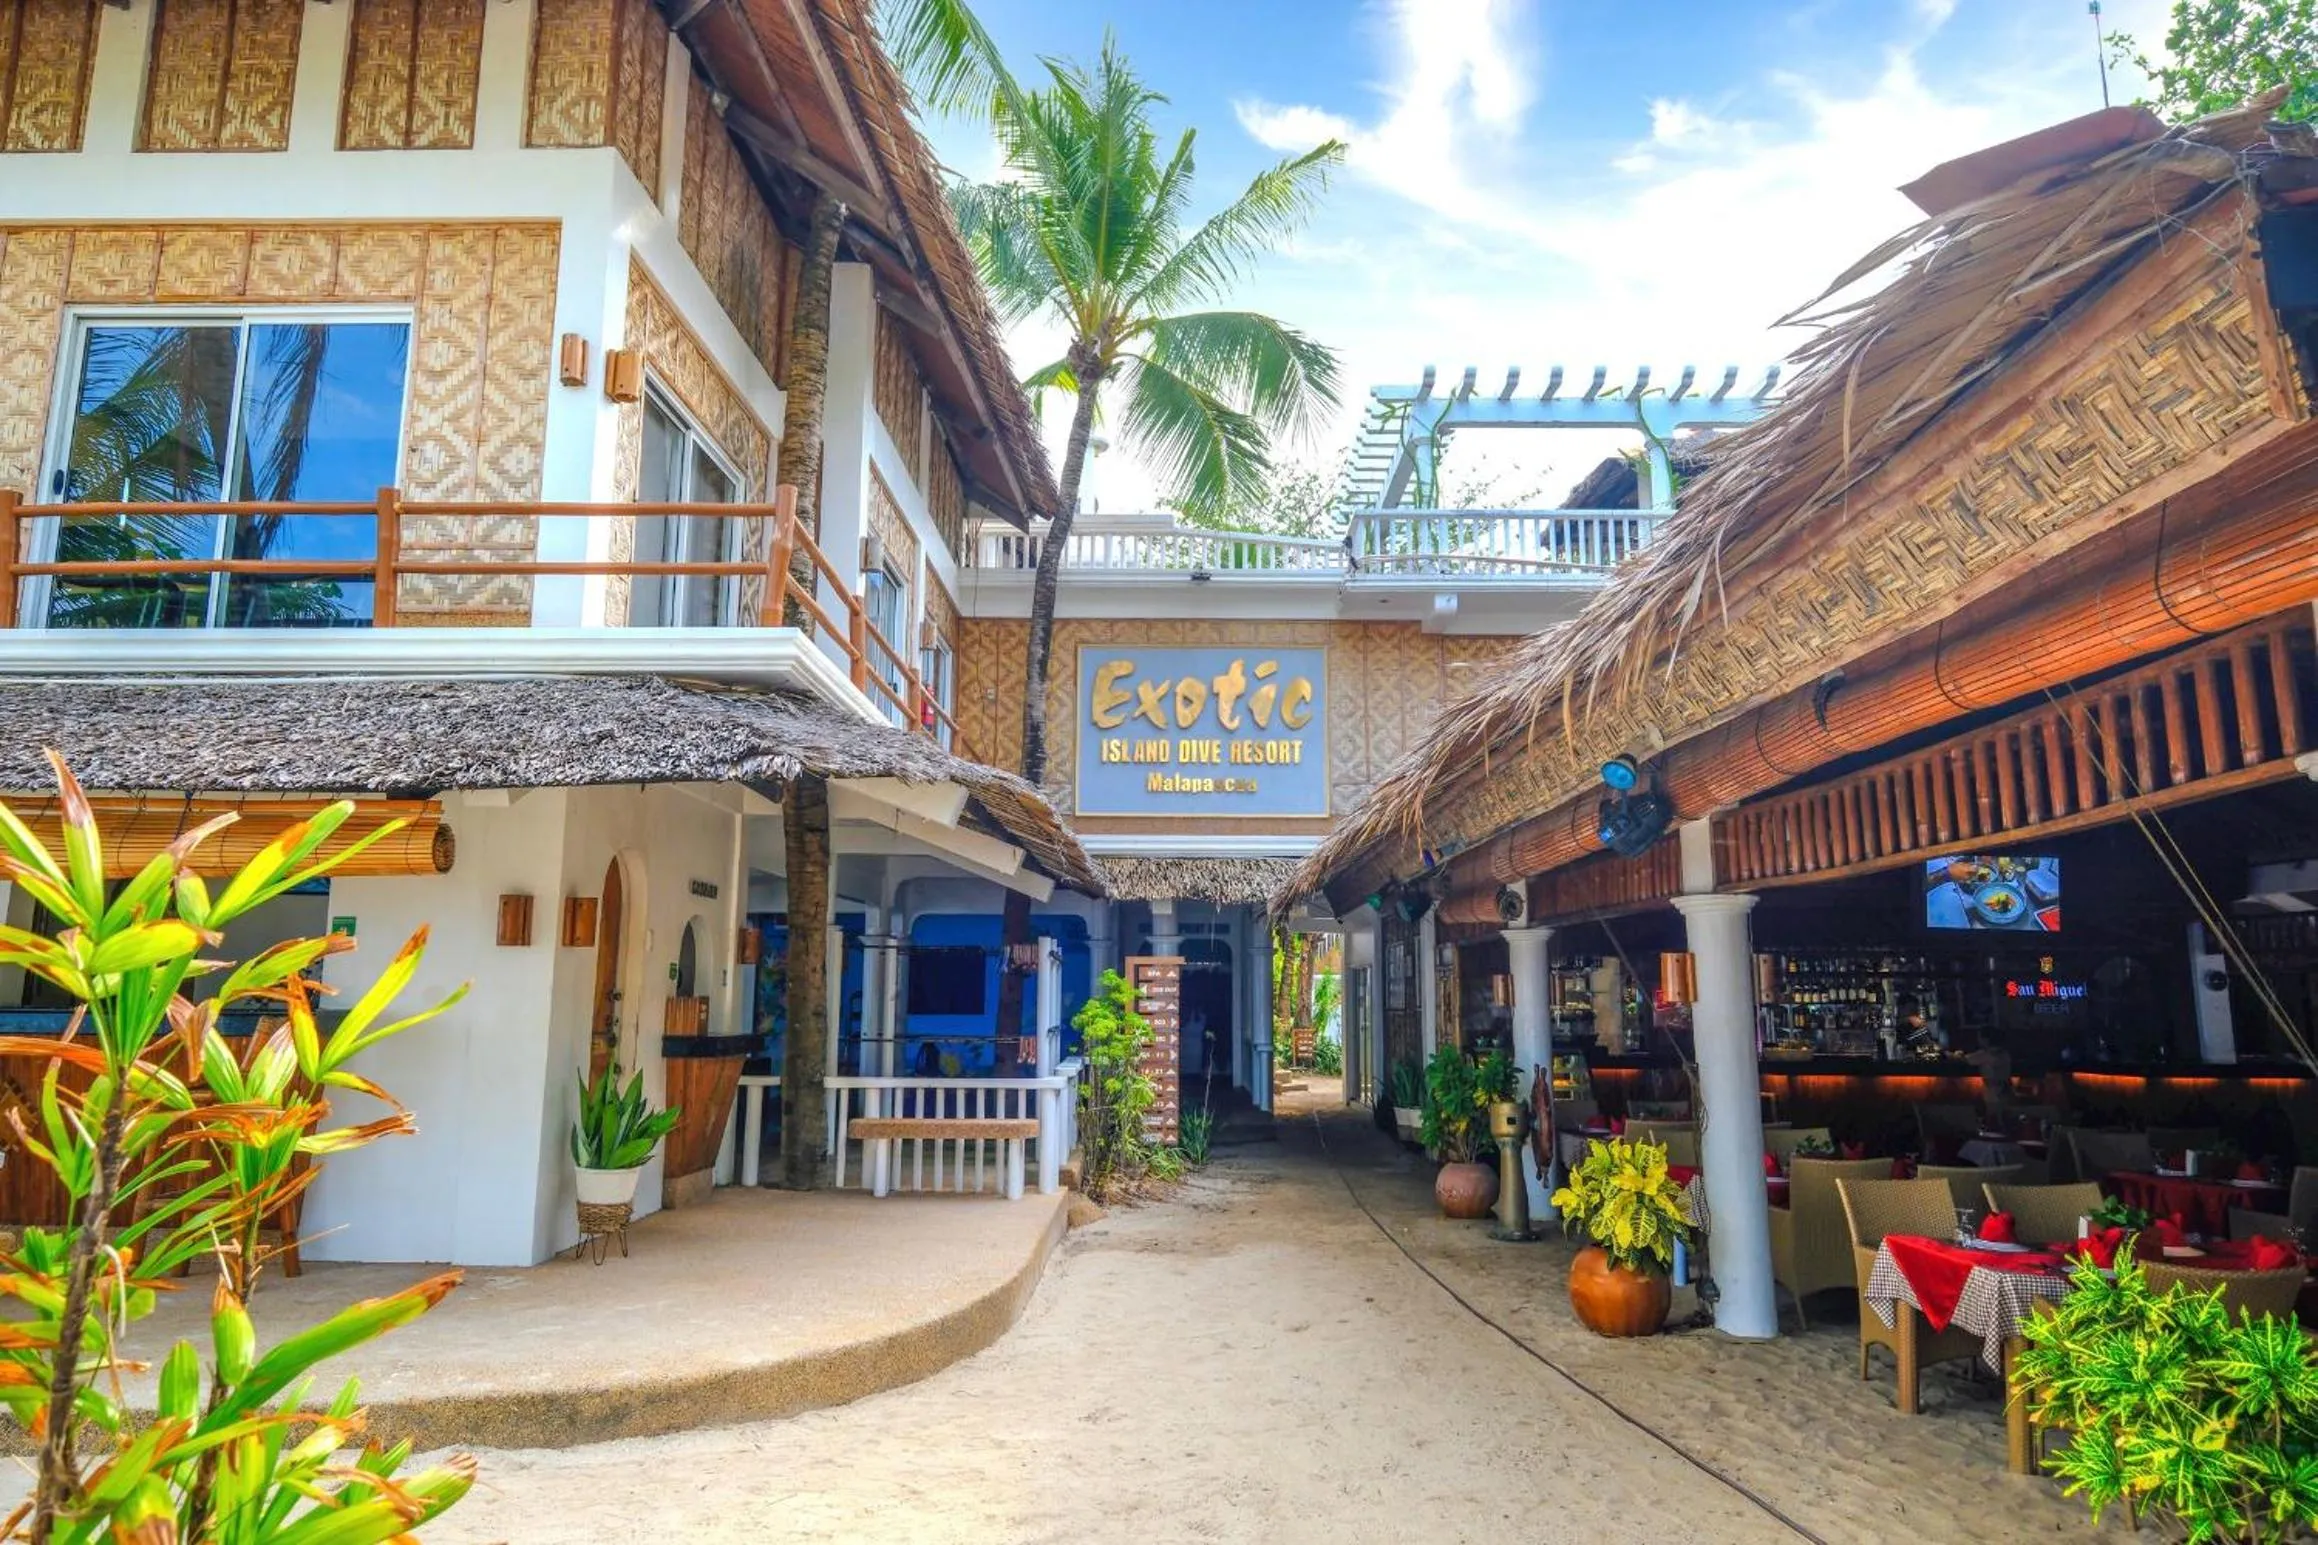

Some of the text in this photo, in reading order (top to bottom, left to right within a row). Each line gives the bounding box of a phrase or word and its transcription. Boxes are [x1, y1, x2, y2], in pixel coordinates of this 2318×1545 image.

[1091, 658, 1313, 731] Exotic
[1101, 739, 1303, 764] ISLAND DIVE RESORT
[2005, 978, 2088, 1000] San Miguel
